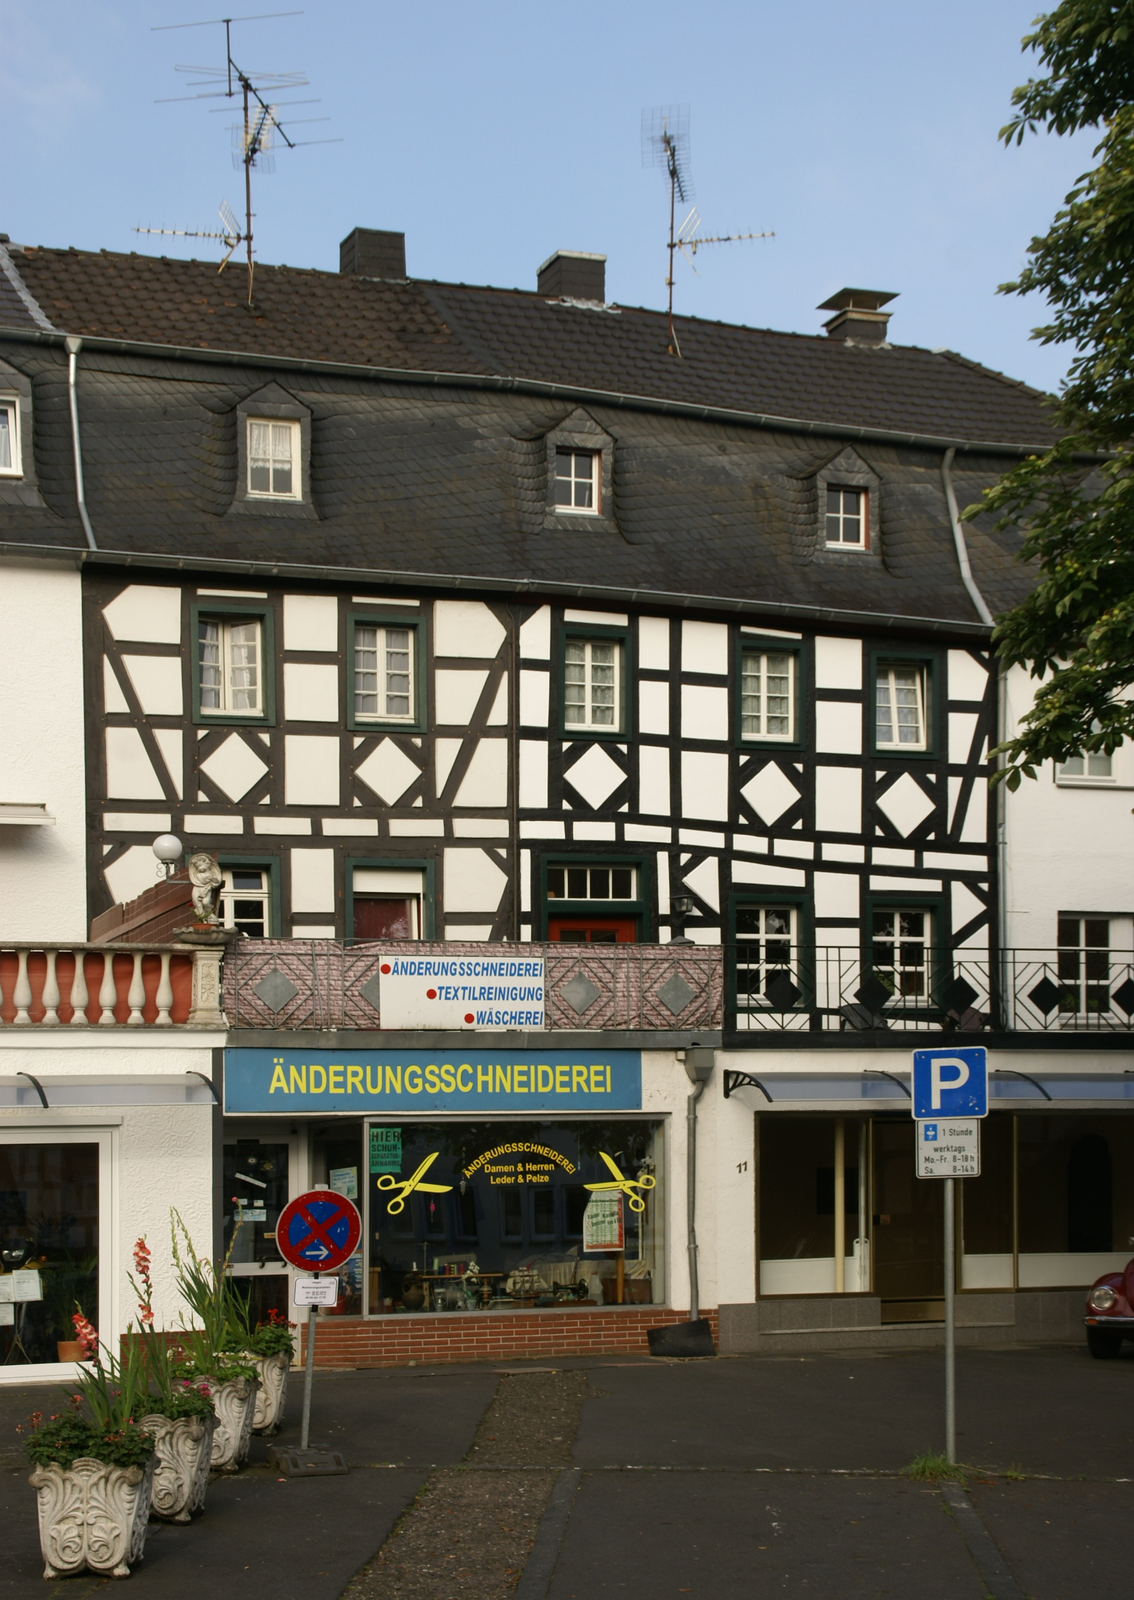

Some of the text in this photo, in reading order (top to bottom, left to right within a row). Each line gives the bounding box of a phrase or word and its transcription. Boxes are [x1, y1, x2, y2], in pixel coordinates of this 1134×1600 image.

[392, 958, 543, 978] ÄNDERUNGSSCHNEIDEREI
[437, 986, 543, 1001] TEXTILREINIGUNG
[476, 1008, 543, 1025] WÄSCHEREI
[269, 1058, 612, 1094] ÄNDERUNGSSCHNEIDEREI
[930, 1057, 970, 1110] P
[371, 1131, 400, 1142] HIER
[942, 1128, 973, 1137] 1 Stunde
[371, 1144, 400, 1152] SCHUH-
[933, 1145, 966, 1154] werktags
[462, 1142, 577, 1179] ÄNDERUNGSSCHNEIDEREI
[924, 1155, 949, 1164] Mo.-Fr.
[970, 1154, 975, 1162] h
[484, 1162, 555, 1173] Damen & Herren
[736, 1160, 747, 1174] 11
[924, 1166, 935, 1174] Sa.
[970, 1165, 975, 1173] h
[490, 1174, 550, 1184] Leder & Pelze
